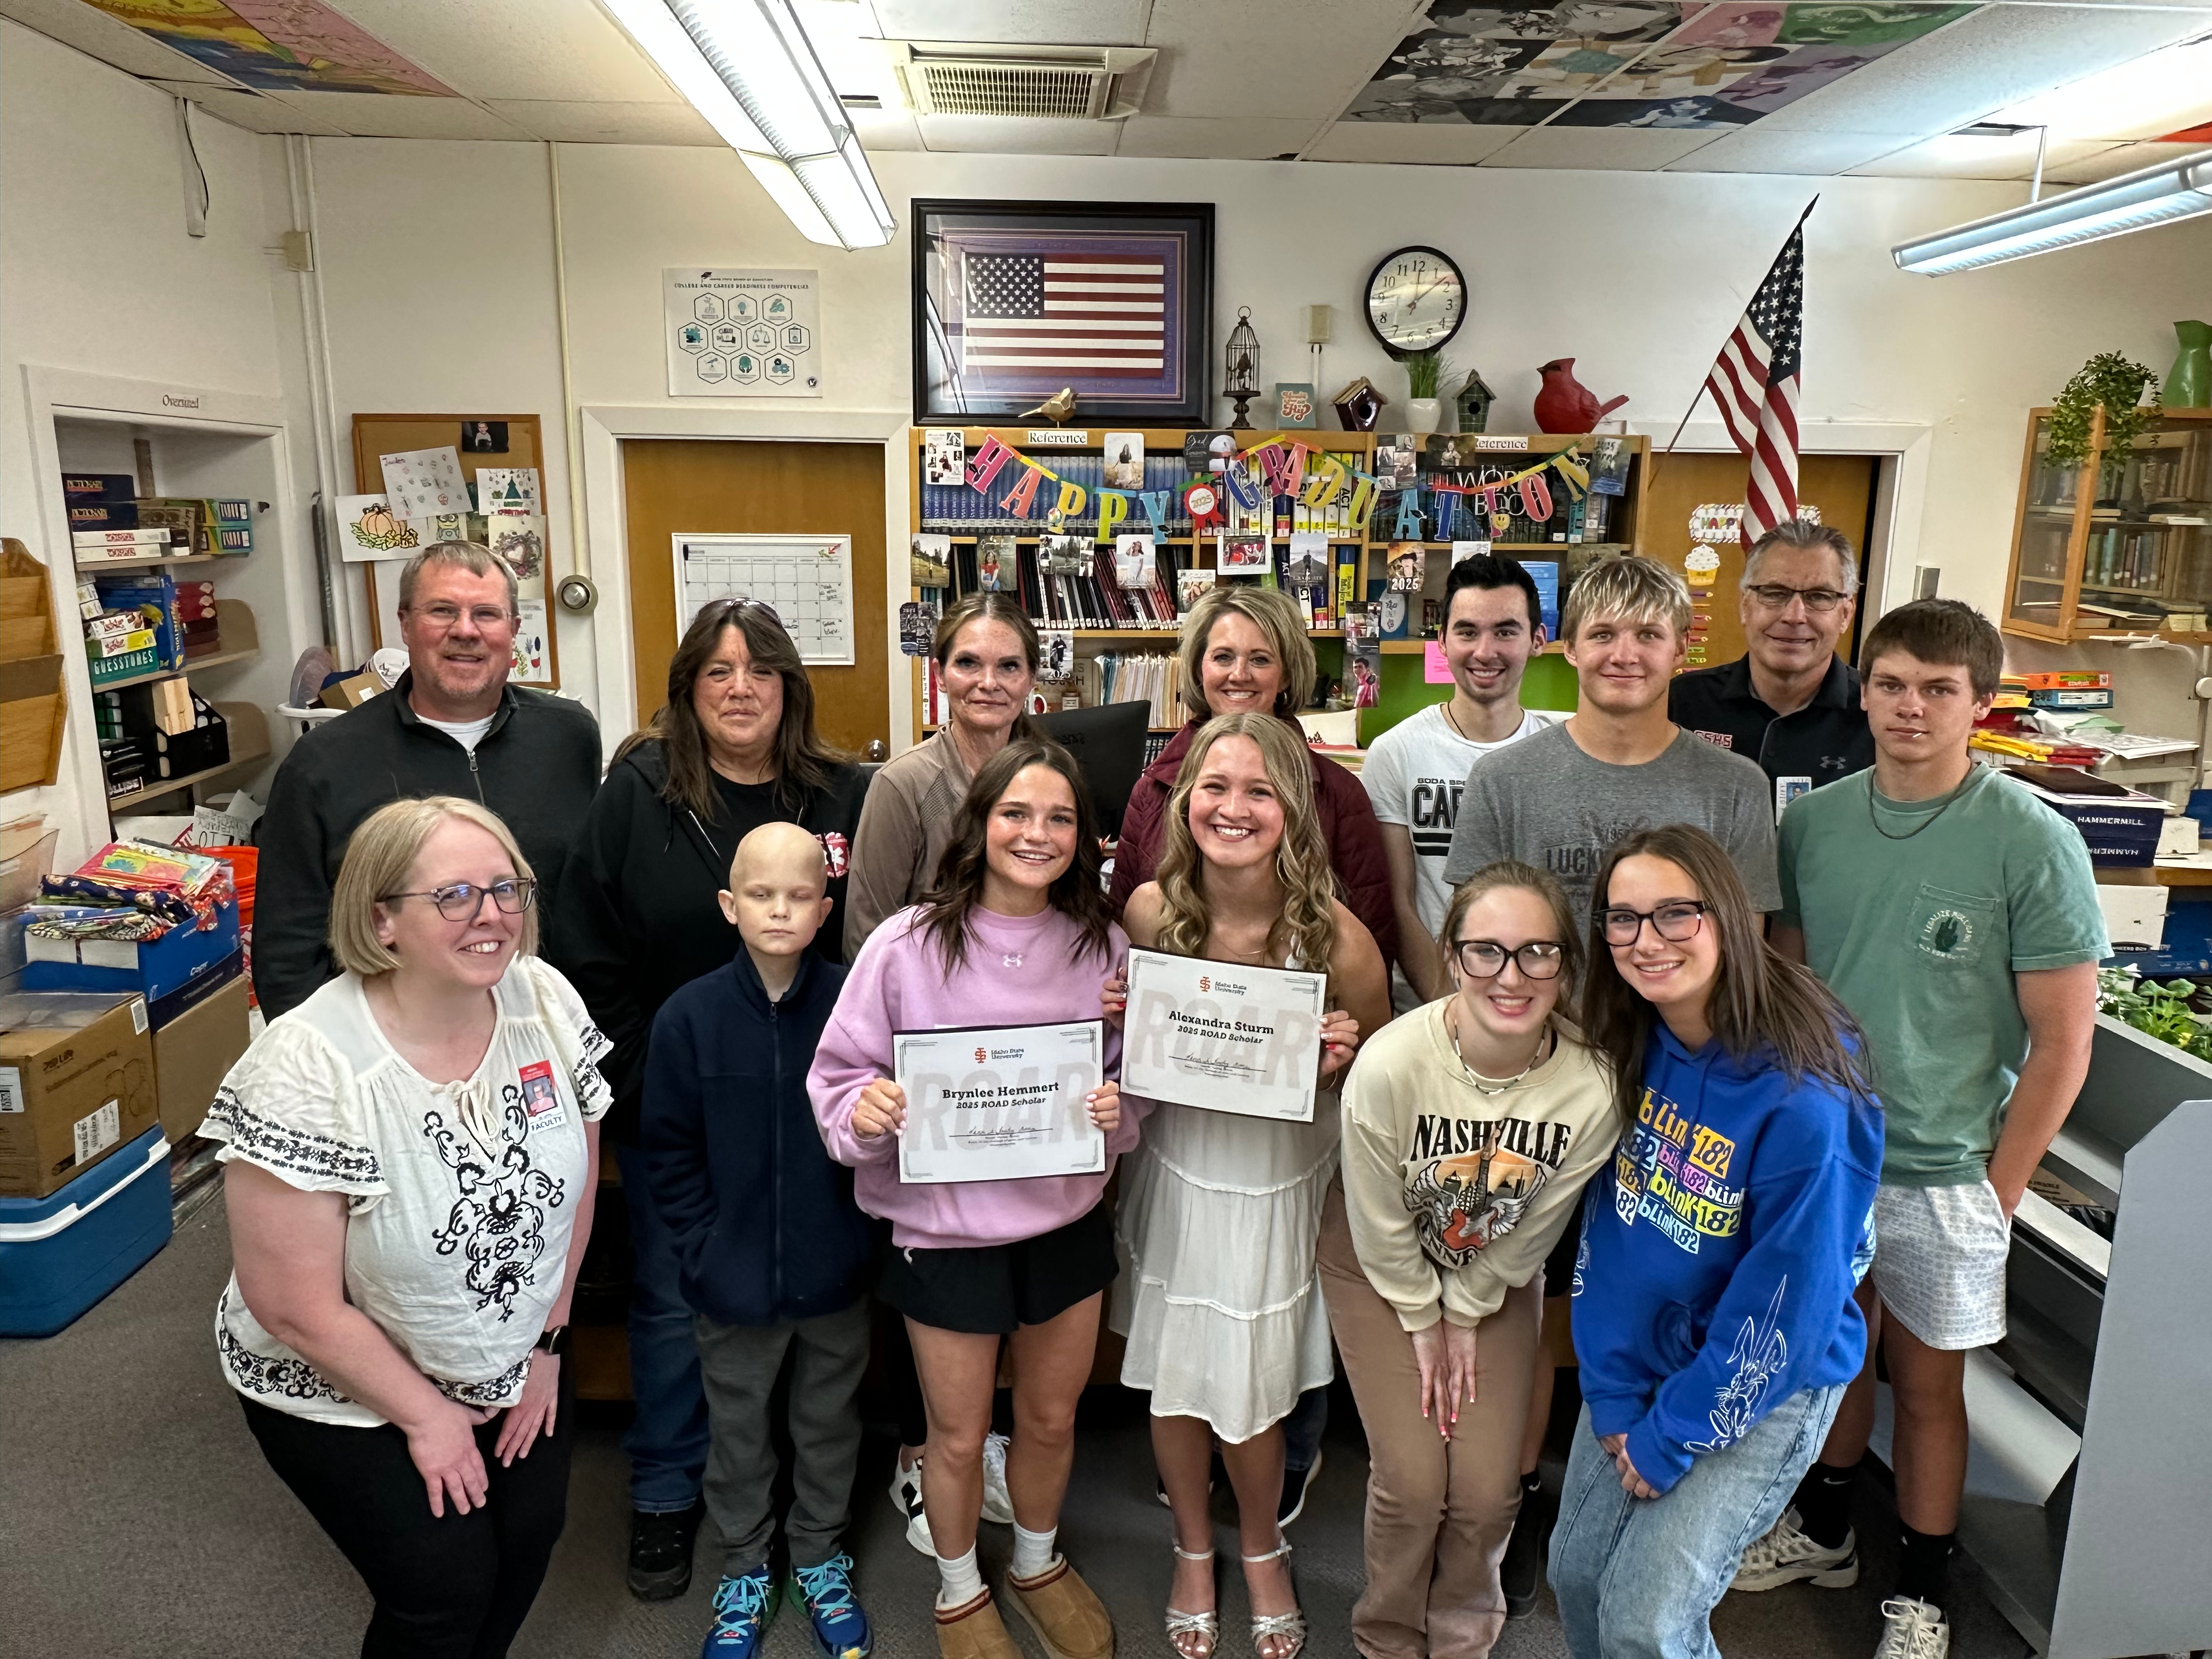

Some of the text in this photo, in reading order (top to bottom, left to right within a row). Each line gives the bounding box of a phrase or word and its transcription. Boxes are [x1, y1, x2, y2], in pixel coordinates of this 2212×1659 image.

[1397, 264, 1408, 276] 11
[1413, 260, 1425, 272] 12
[1434, 267, 1438, 279] 1
[1384, 276, 1395, 287] 10
[1443, 281, 1450, 292] 2
[1446, 299, 1453, 310] 3
[1380, 312, 1387, 324] 8
[1439, 317, 1446, 329] 4
[1391, 325, 1399, 337] 7
[1407, 331, 1415, 342] 6
[1029, 432, 1086, 443] Reference
[965, 434, 1590, 544] HAPPY GRADUATION
[1340, 488, 1350, 510] ACT
[1391, 578, 1419, 590] 2025
[94, 650, 154, 675] GUESSTURES
[2078, 816, 2146, 825] HAMMERMILL
[1169, 1011, 1274, 1035] Alexandra Sturm
[1127, 989, 1314, 1088] ROAR
[1177, 1025, 1263, 1045] 2025 ROAD Scholar
[943, 1082, 1059, 1101] Brynlee Hemmert
[906, 1061, 1096, 1152] ROAR
[981, 1100, 1008, 1108] ROAD
[1011, 1097, 1046, 1107] Scholar
[531, 1115, 562, 1131] FACULTY
[1410, 1114, 1571, 1170] NASHVILLE
[1694, 1135, 1731, 1175] 182
[1685, 1167, 1705, 1194] 182
[1649, 1166, 1740, 1234] blink 182
[1638, 1195, 1699, 1252] blink 182
